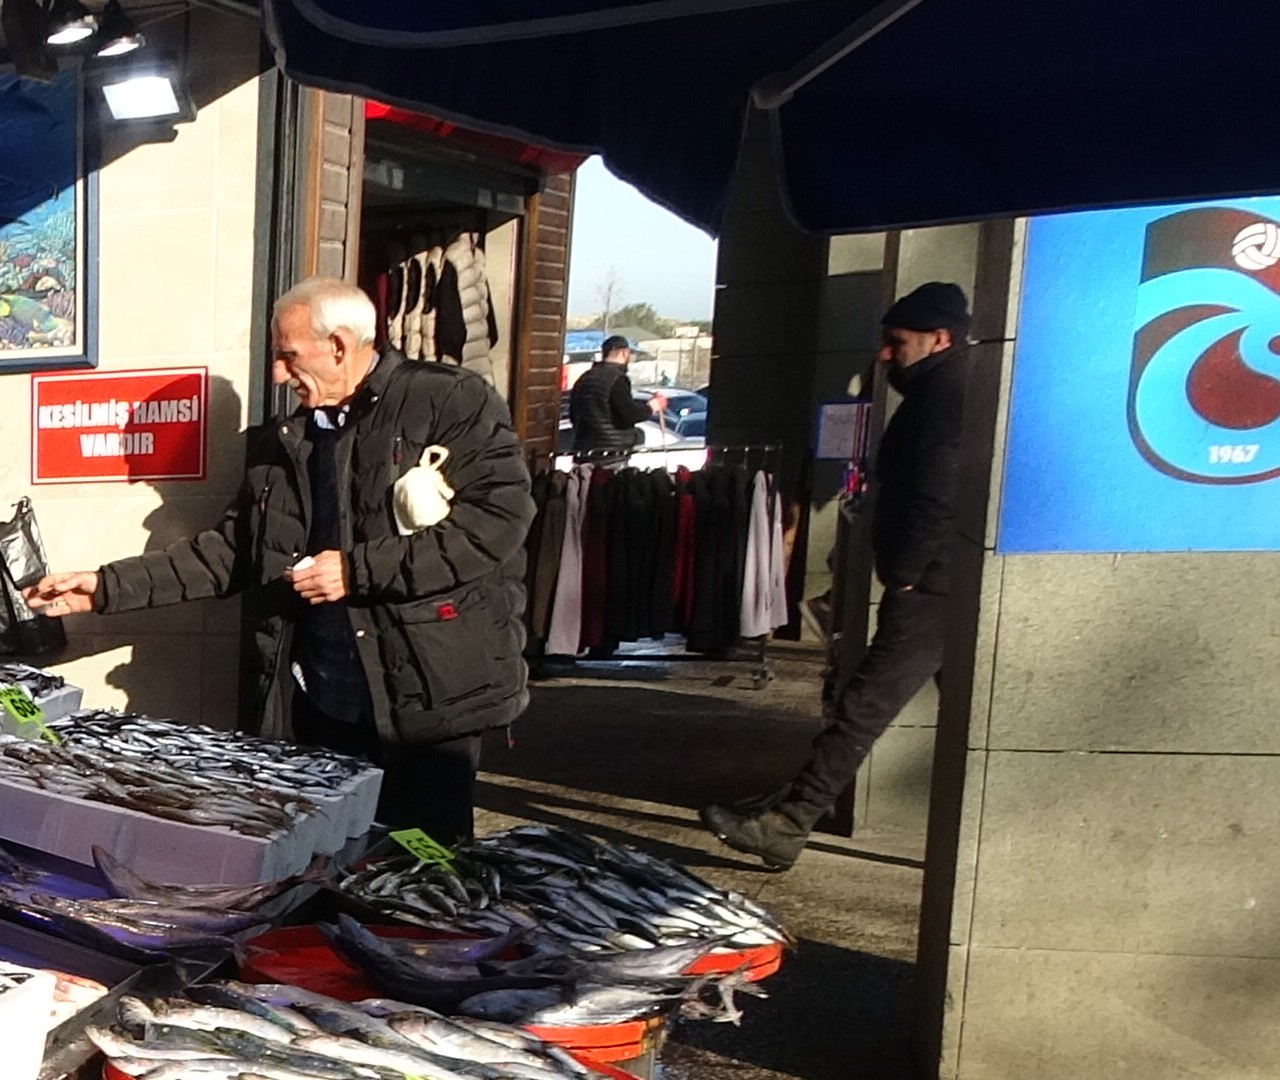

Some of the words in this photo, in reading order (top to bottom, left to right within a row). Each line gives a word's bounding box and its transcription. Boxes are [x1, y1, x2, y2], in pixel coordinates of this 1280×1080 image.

[39, 398, 130, 430] KESİLMİŞ
[132, 395, 199, 425] HAMSİ
[79, 432, 154, 458] VARDIR
[1207, 444, 1261, 465] 1967
